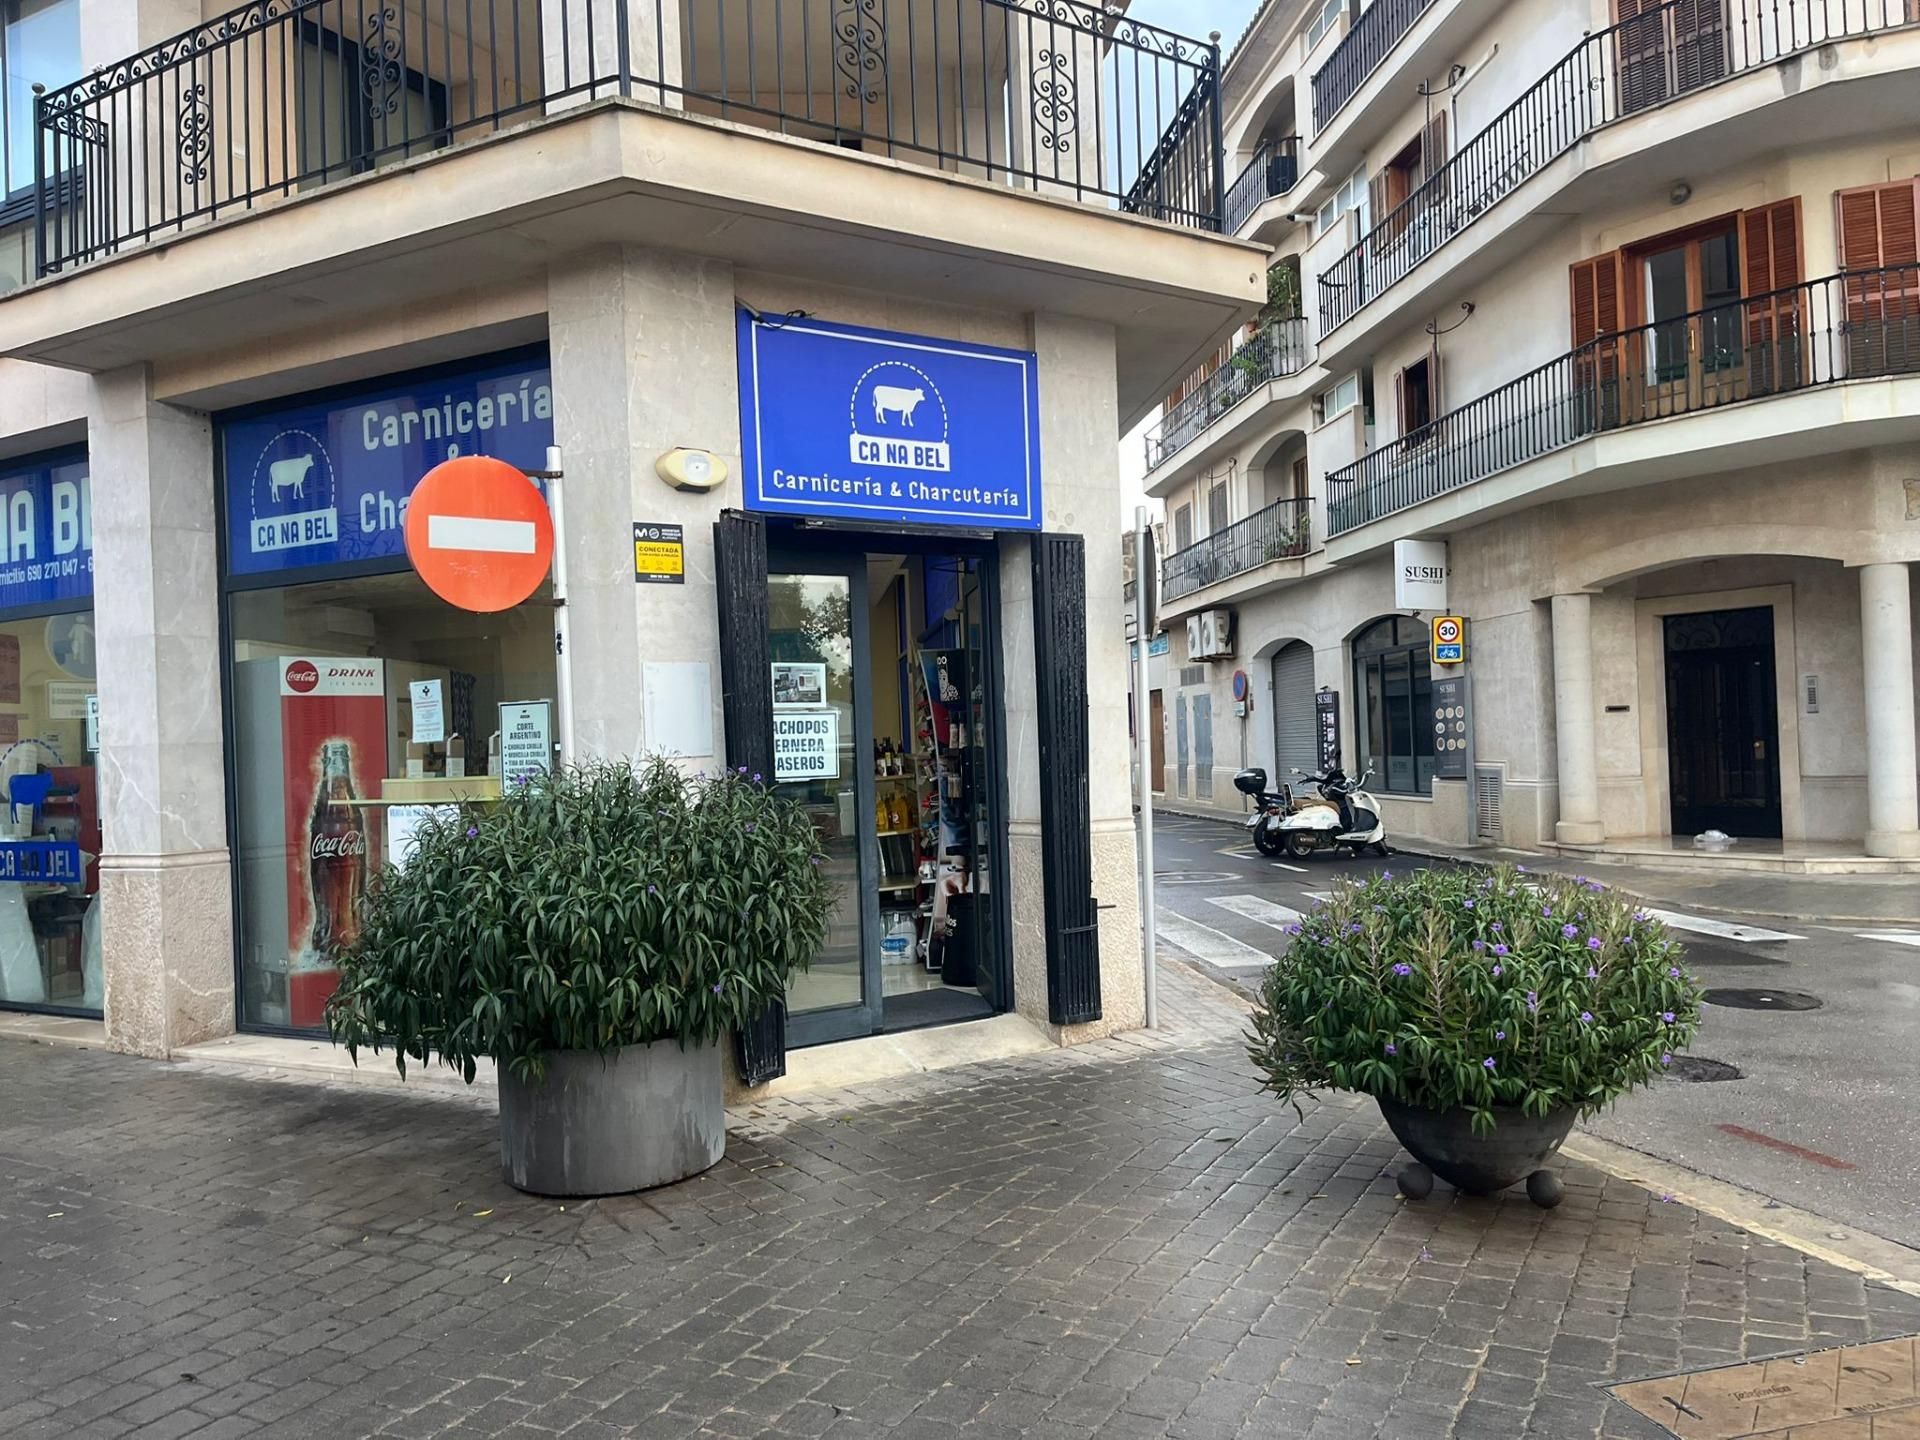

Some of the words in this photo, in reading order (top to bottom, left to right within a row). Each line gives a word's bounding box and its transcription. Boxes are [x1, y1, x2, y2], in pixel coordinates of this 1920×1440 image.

[363, 379, 552, 450] Carnicería
[859, 441, 880, 463] CA
[887, 443, 908, 465] NA
[915, 446, 945, 468] BEL
[773, 469, 882, 496] Carnicería
[890, 481, 902, 497] &
[909, 481, 1019, 506] Charcutería
[258, 525, 275, 547] CA
[281, 521, 299, 544] NA
[305, 517, 332, 540] BEL
[27, 563, 42, 582] 690
[44, 561, 60, 579] 270
[62, 558, 78, 576] 047
[1405, 566, 1443, 579] SUSHI
[1441, 626, 1456, 636] 30
[328, 668, 375, 677] DRINK
[510, 731, 541, 740] ARGENTINO
[517, 722, 534, 731] CORTE
[312, 830, 364, 860] Coca-Cola
